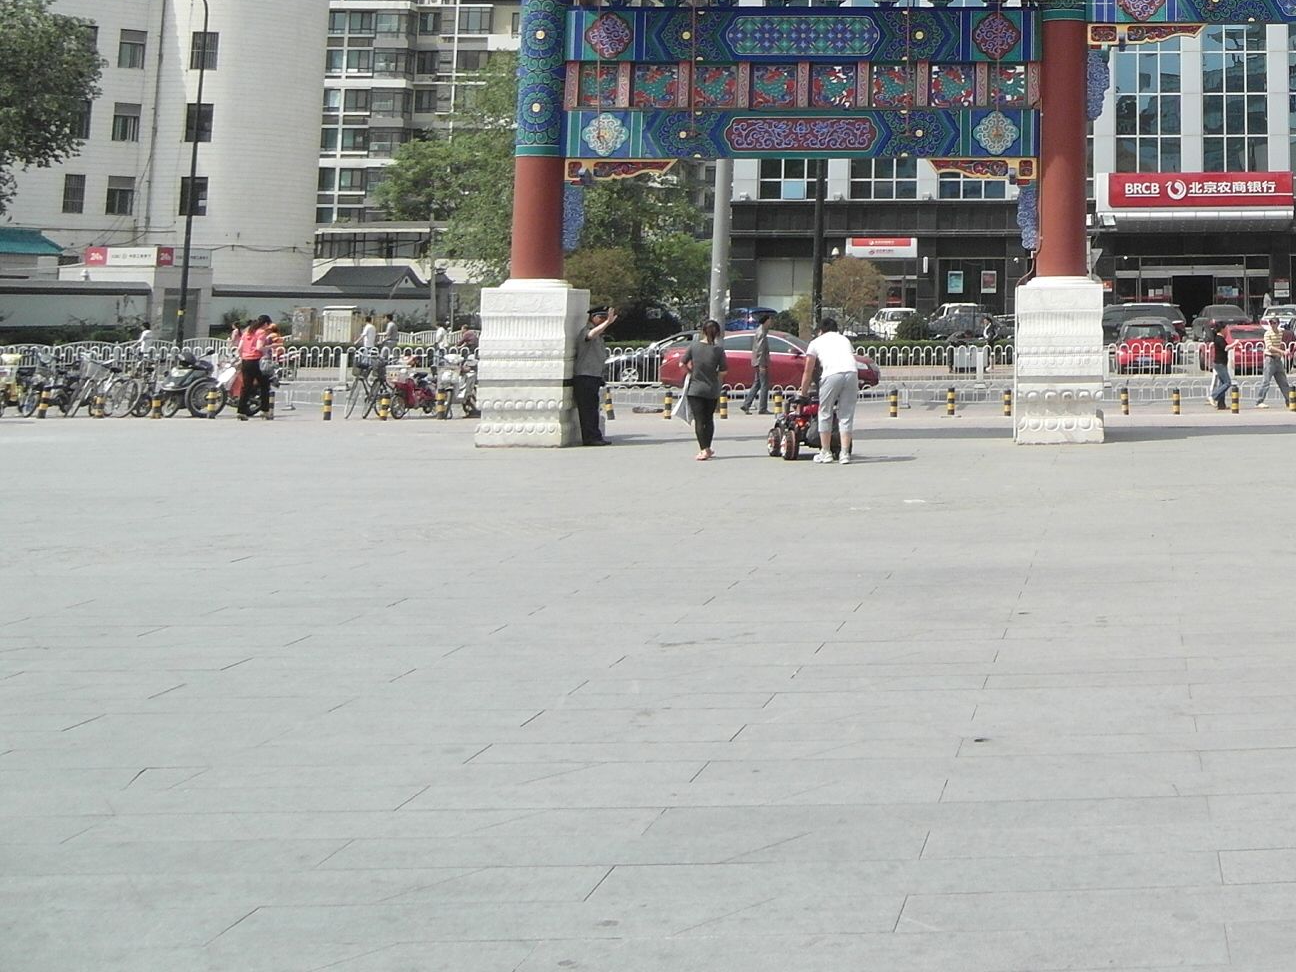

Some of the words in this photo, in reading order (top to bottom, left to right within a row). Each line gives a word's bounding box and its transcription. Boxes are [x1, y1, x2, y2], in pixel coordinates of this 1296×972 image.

[1124, 182, 1160, 194] BRCB
[1188, 180, 1277, 194] 北京农商银行
